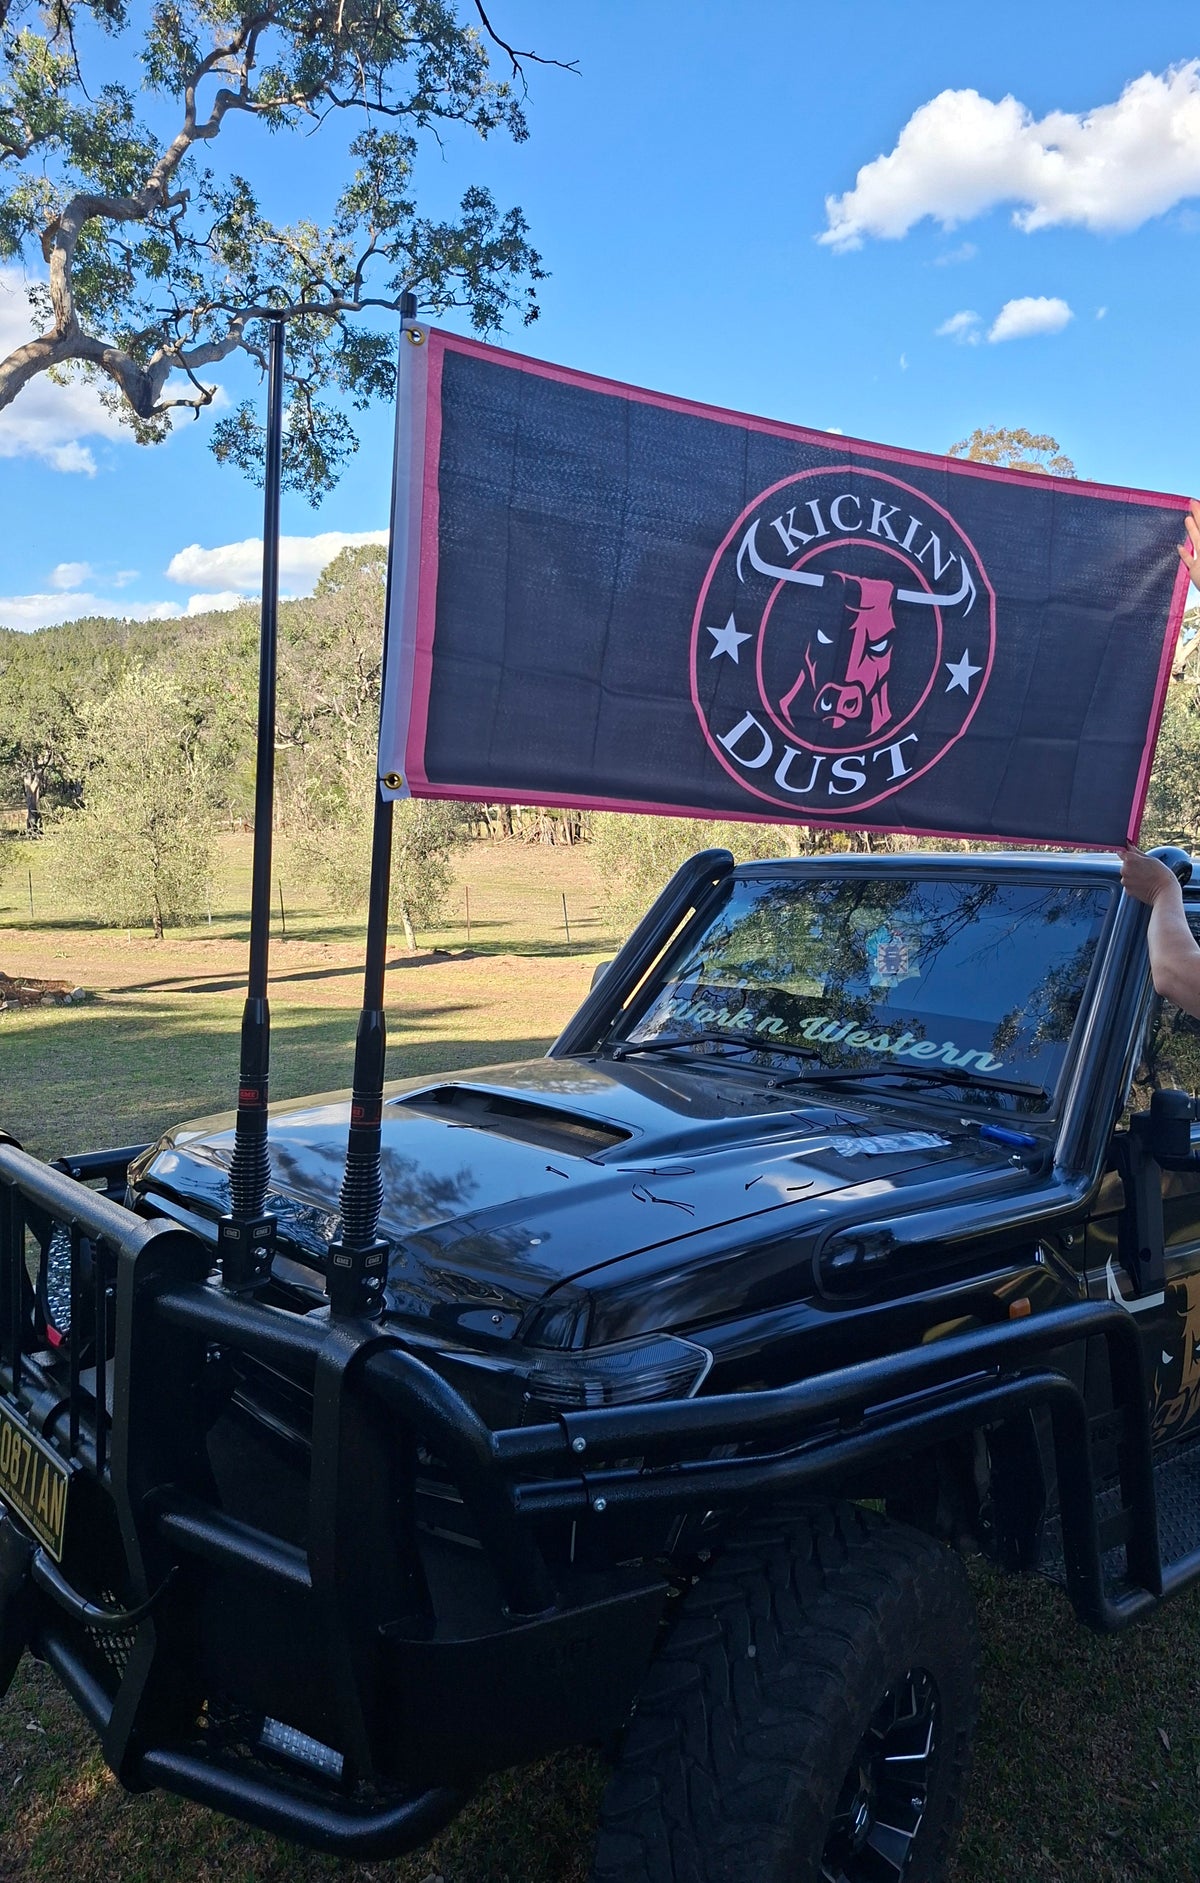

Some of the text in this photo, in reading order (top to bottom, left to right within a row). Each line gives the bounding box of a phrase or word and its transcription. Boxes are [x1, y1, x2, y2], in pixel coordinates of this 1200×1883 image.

[770, 494, 957, 581] KICKIN
[716, 711, 919, 796] DUST
[669, 998, 1004, 1072] Work n Western
